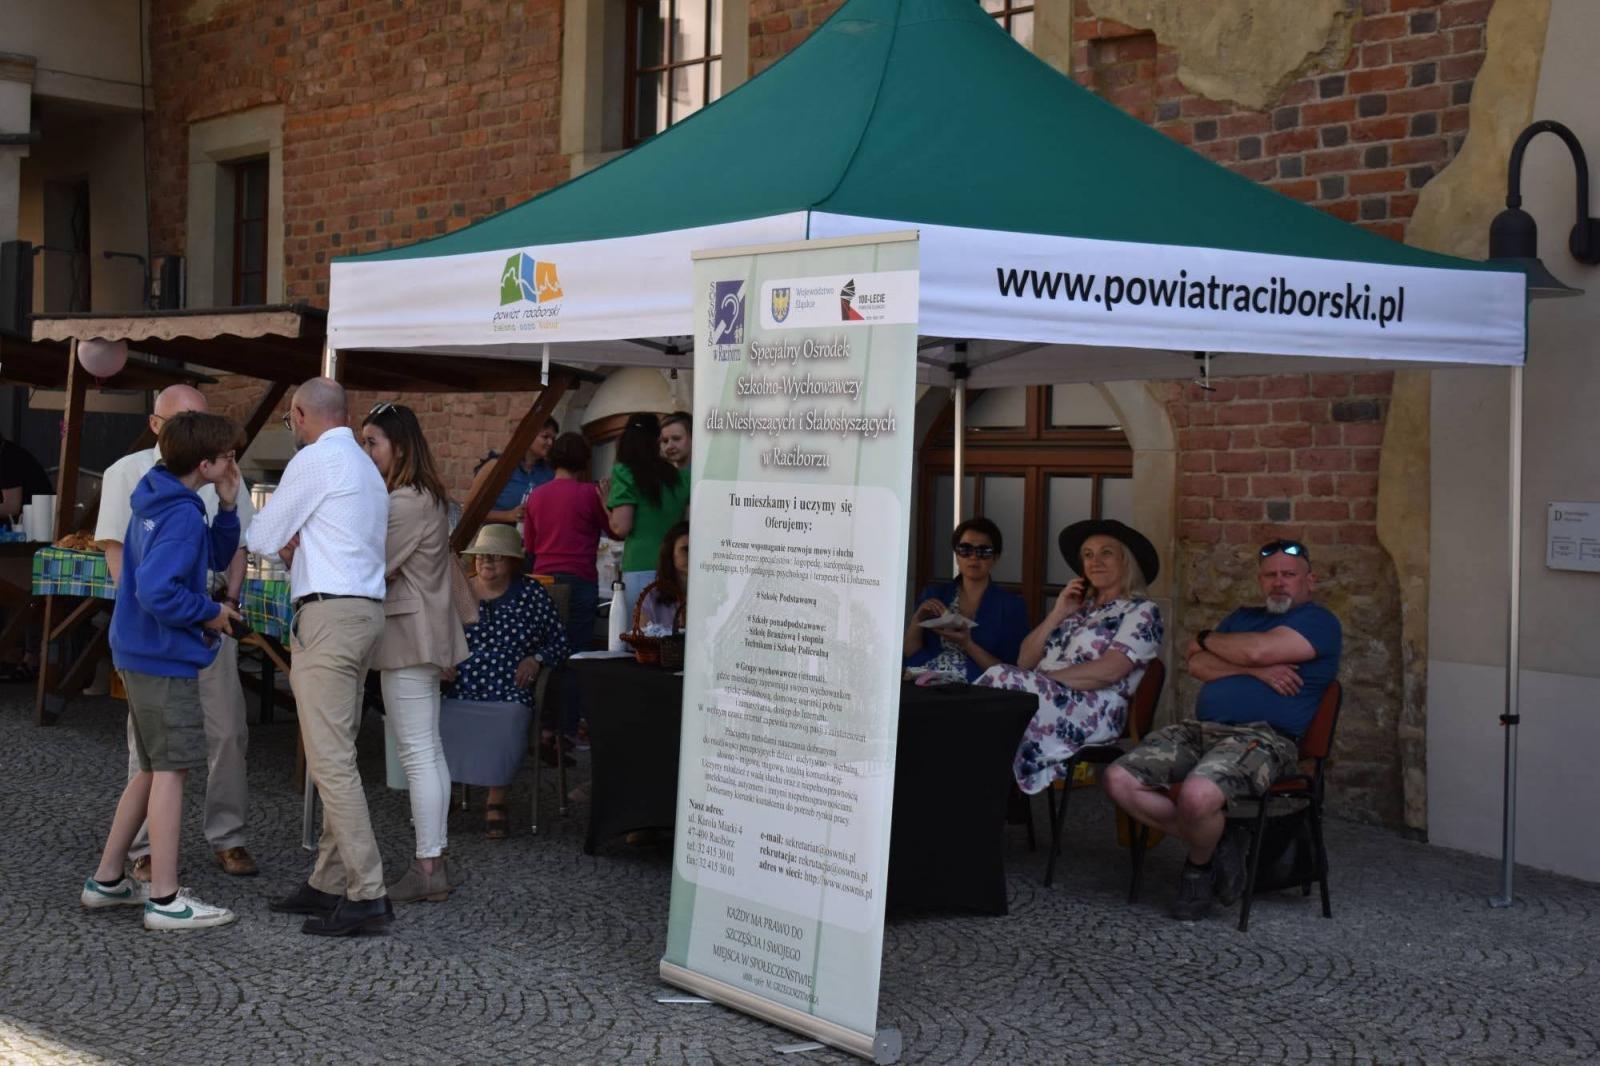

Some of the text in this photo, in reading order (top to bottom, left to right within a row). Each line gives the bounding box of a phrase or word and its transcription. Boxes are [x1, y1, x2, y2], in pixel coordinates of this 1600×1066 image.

[858, 293, 886, 305] 100-LECIE
[996, 267, 1405, 329] www.powiatraciborski.pl
[750, 335, 851, 367] Specjalny Ośrodek
[736, 372, 863, 401] Szkolno-Wychowawczy
[706, 408, 896, 439] dla Niesłyszących i Słabosłyszących
[761, 445, 831, 468] w Raciborzu
[728, 492, 853, 517] Tu mieszkamy i uczymy się
[764, 516, 813, 534] Oferujemy:
[813, 547, 831, 558] mowy
[689, 798, 724, 816] Nasz adres:
[697, 814, 717, 829] Karola
[718, 819, 738, 834] Miarki
[738, 825, 744, 836] 4
[706, 845, 717, 857] 415
[759, 845, 797, 865] rekrutacja:
[760, 831, 857, 866] e-mail: sekretariat@oswnis.pl
[707, 860, 718, 873] 415
[759, 860, 777, 873] adres
[778, 866, 784, 874] w
[785, 867, 803, 881] sieci:
[726, 905, 804, 941] KAŻDY MA PRAWO DO
[725, 927, 762, 950] SZCZĘŚCIA
[767, 940, 801, 962] SWOJEGO
[712, 943, 741, 963] MIEJSCA
[740, 953, 750, 967] W
[750, 956, 813, 989] SPOŁECZEŃSTWIE
